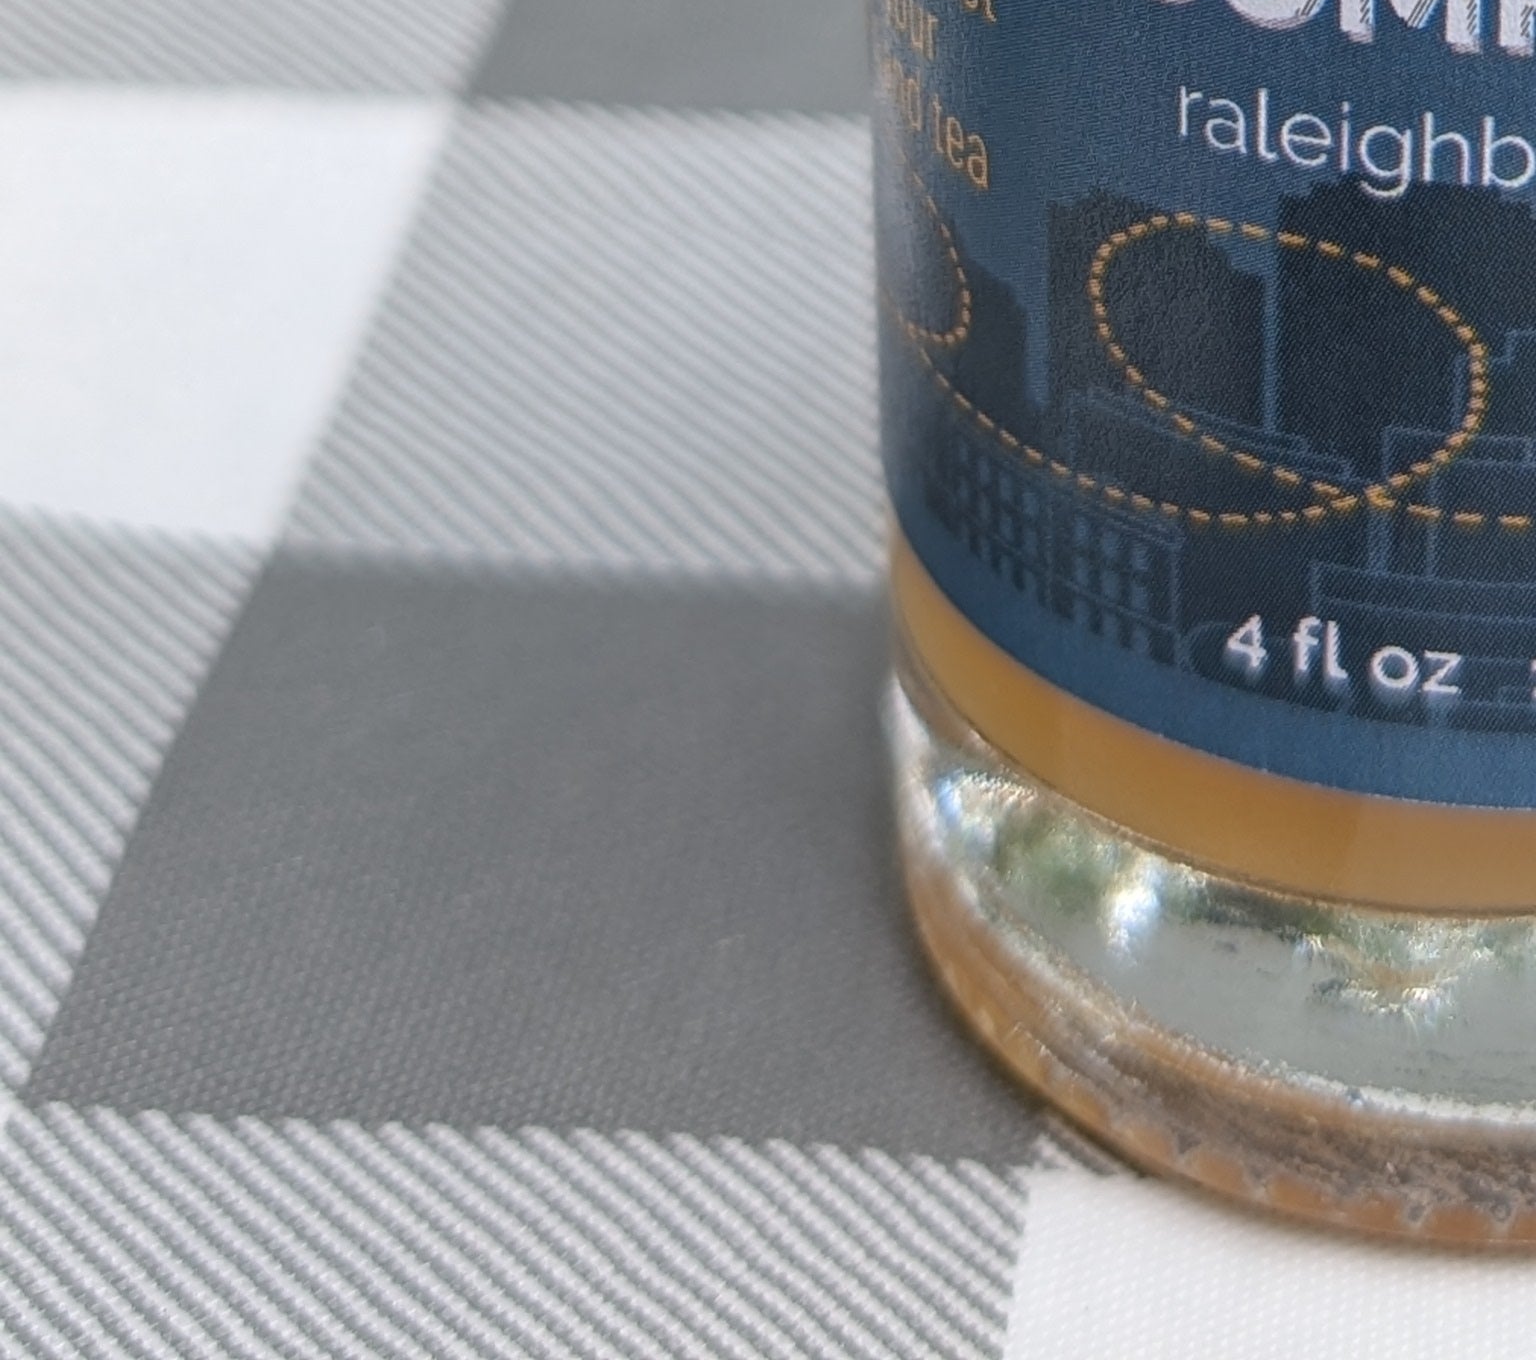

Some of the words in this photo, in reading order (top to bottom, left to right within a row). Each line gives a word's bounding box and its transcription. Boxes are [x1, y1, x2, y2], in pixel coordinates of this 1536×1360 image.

[931, 93, 990, 191] tea
[1225, 613, 1268, 670] 4
[1292, 615, 1350, 682] fl
[1368, 643, 1463, 696] oz
